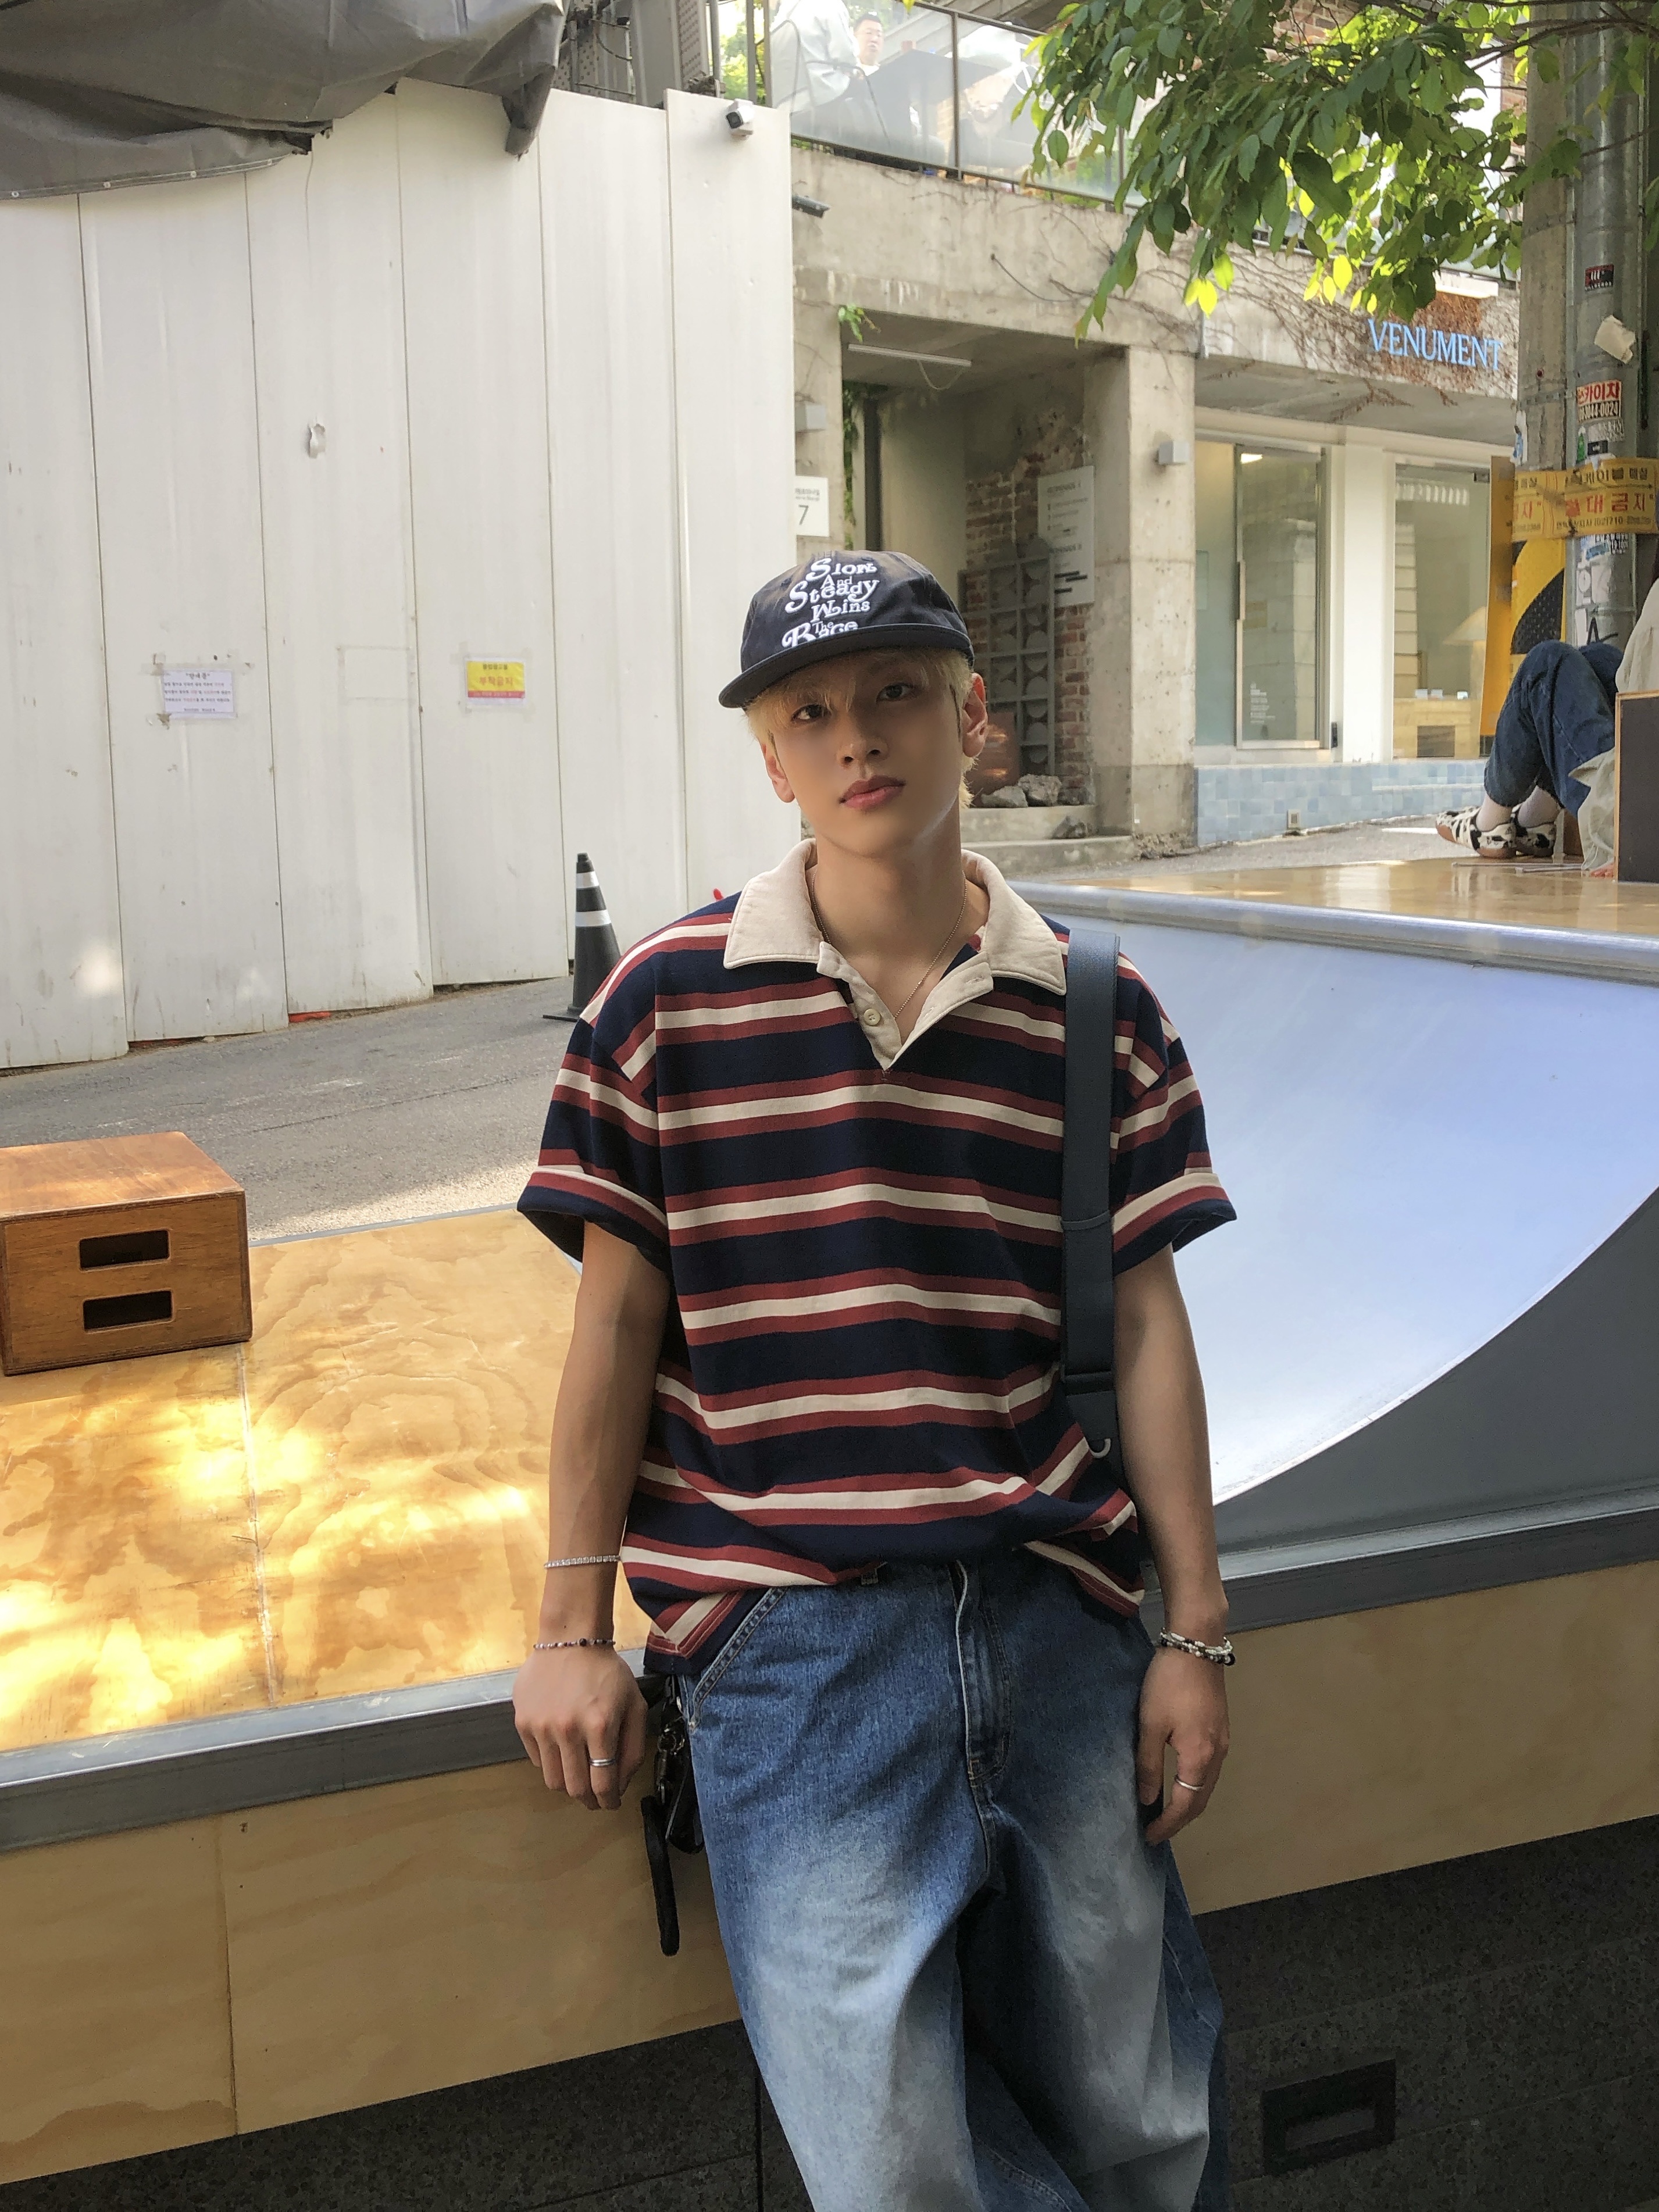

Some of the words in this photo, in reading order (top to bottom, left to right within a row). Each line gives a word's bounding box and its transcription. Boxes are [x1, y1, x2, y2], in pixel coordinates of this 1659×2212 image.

[1368, 319, 1503, 371] VENUMENT
[798, 504, 809, 526] 7
[805, 558, 877, 581] Slow
[820, 574, 852, 589] And
[785, 580, 880, 614] Steady
[810, 599, 870, 623] Wins
[782, 621, 859, 648] Race
[812, 620, 834, 634] The
